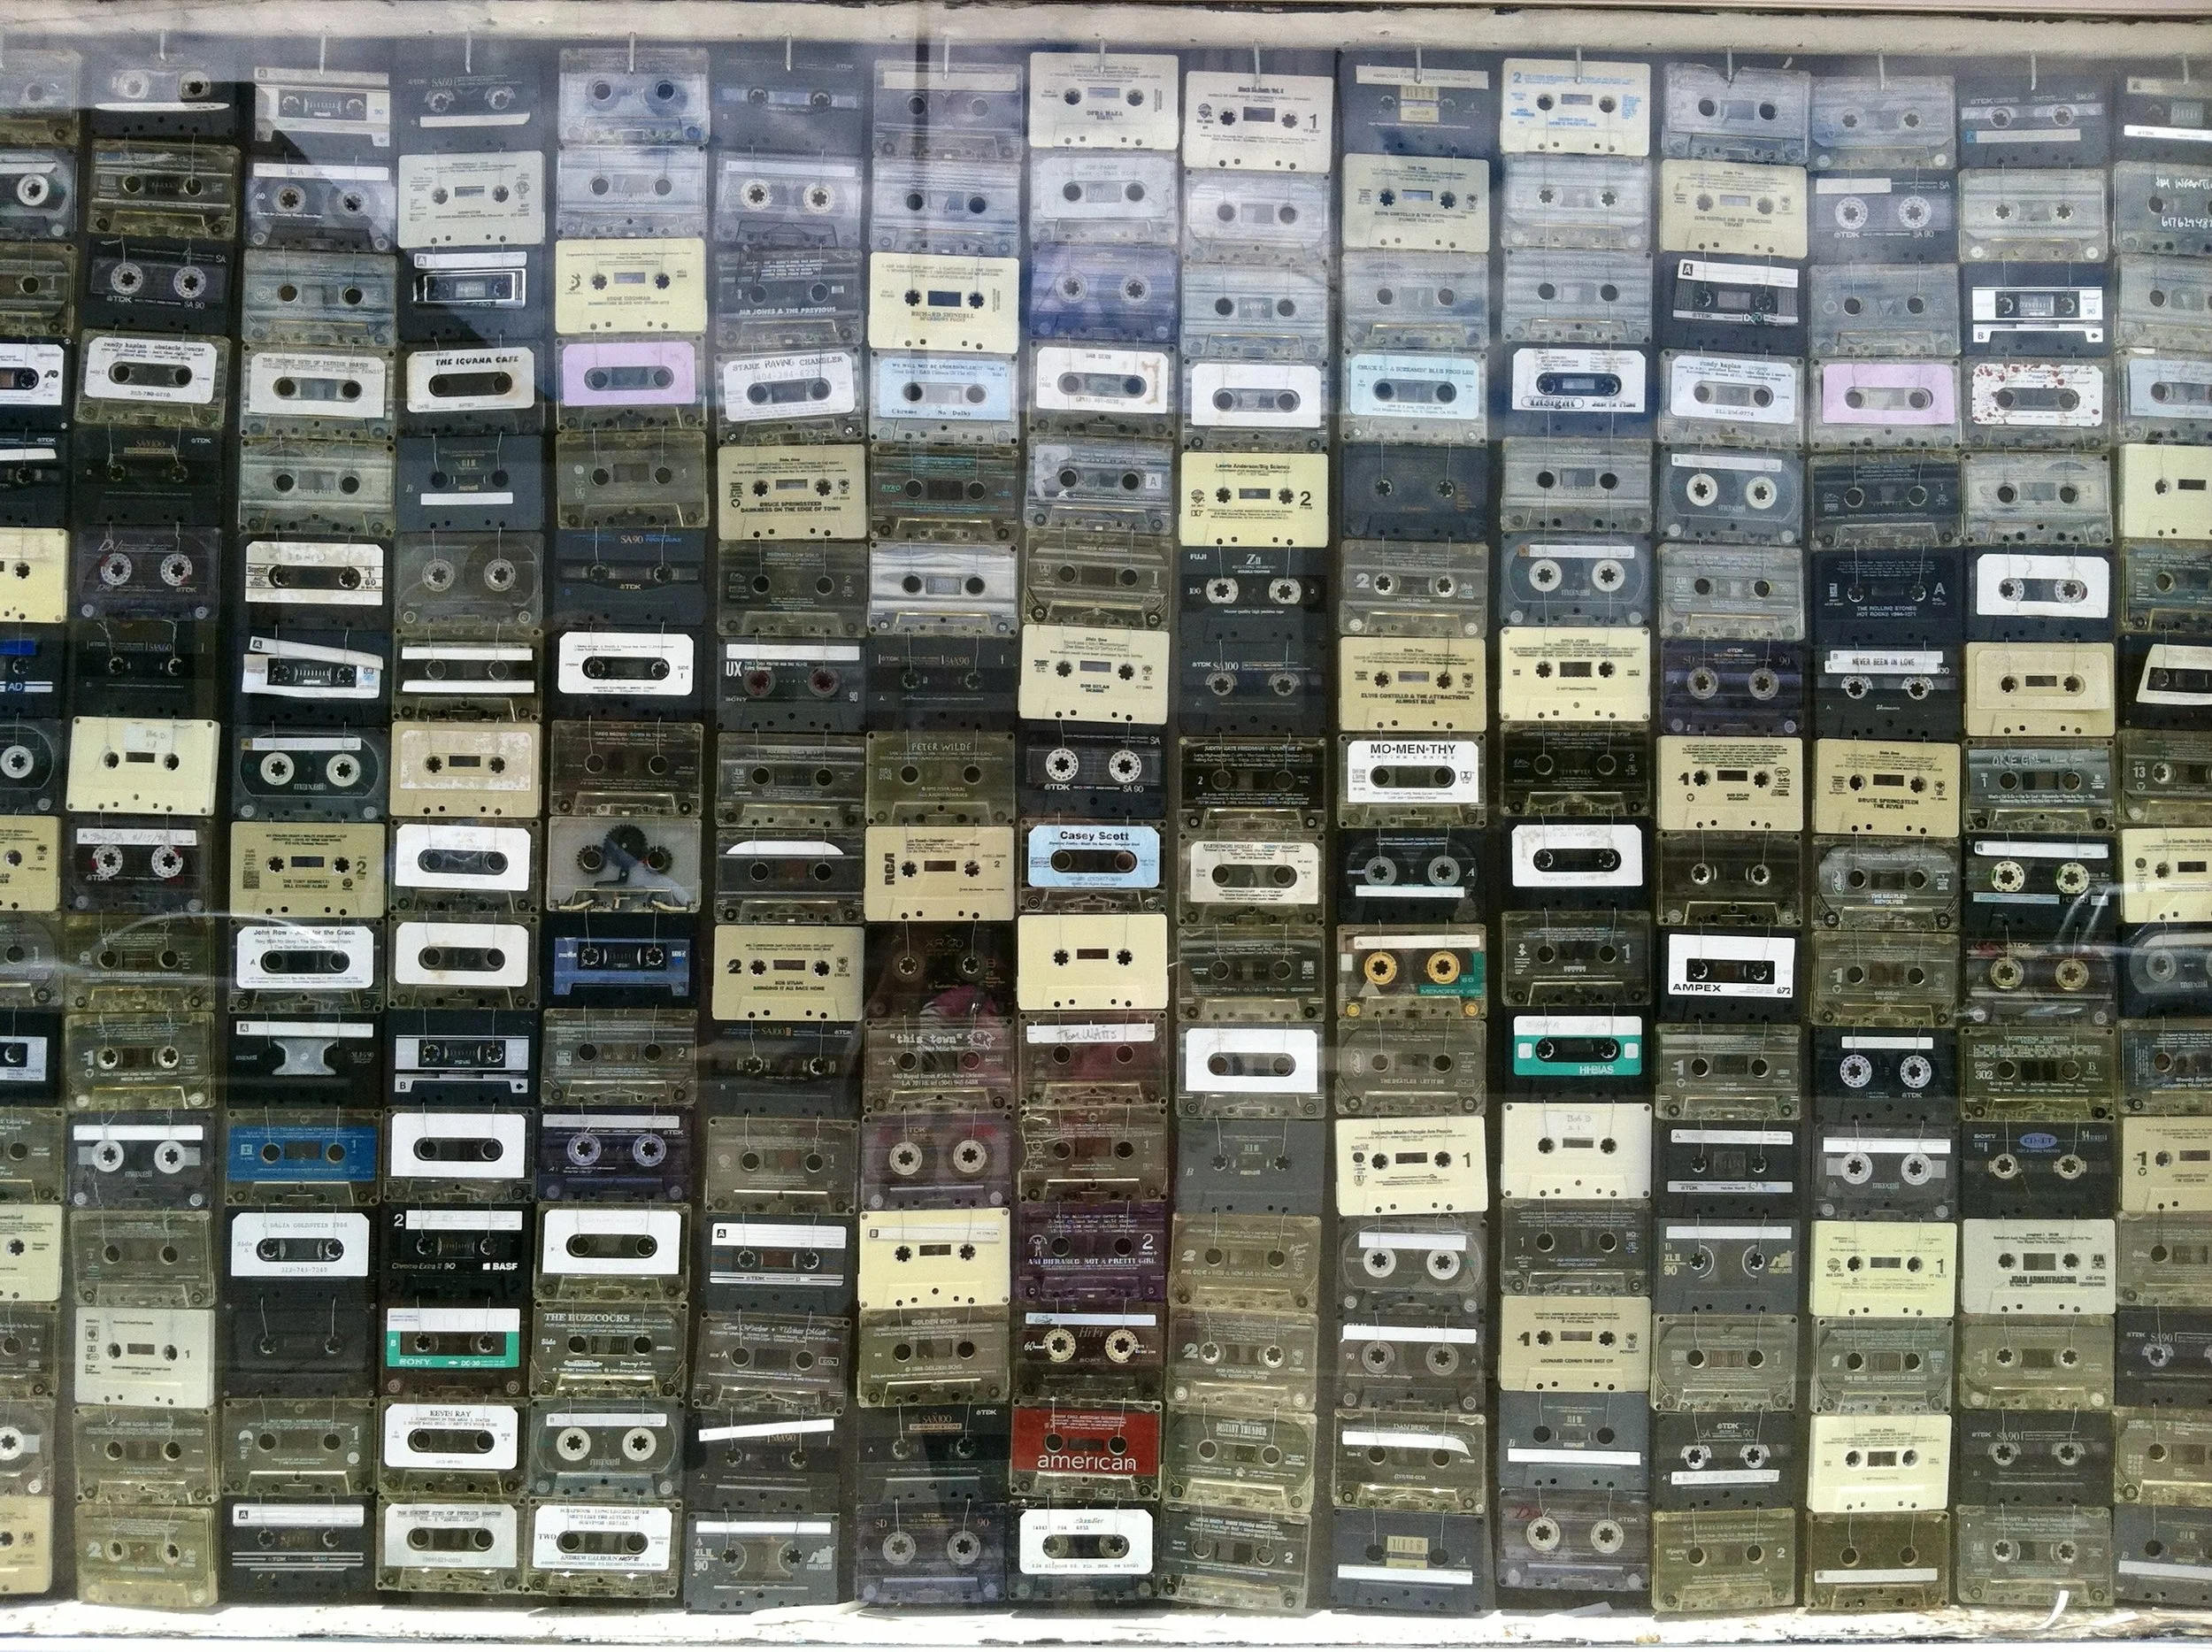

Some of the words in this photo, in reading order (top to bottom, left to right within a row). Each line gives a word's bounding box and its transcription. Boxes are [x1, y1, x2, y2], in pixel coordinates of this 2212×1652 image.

[1513, 72, 1521, 83] 2
[1310, 113, 1317, 128] 1
[215, 254, 227, 264] SA
[1683, 264, 1692, 276] A
[112, 295, 132, 304] TDK
[184, 300, 194, 309] SA
[195, 301, 205, 310] 90
[435, 357, 451, 366] THE
[456, 357, 492, 365] IGUANA
[732, 363, 761, 372] STARK
[764, 357, 795, 368] RAVING
[799, 356, 843, 366] CHANDLER
[1300, 491, 1311, 506] 2
[1356, 572, 1370, 588] 2
[1933, 584, 1945, 595] A
[1683, 656, 1695, 665] SD
[1778, 656, 1790, 666] 90
[726, 661, 741, 677] UX
[8, 682, 23, 691] AD
[849, 692, 858, 703] 90
[1150, 735, 1160, 745] SA
[911, 742, 939, 751] PETER
[941, 742, 972, 751] WILDE
[2132, 766, 2146, 778] 13
[1060, 831, 1094, 841] Casey
[1099, 830, 1129, 841] Scott
[356, 860, 366, 874] 2
[885, 852, 895, 885] RCA
[1622, 944, 1631, 959] 1
[727, 960, 741, 973] 2
[1673, 983, 1721, 993] AMPEX
[889, 1033, 923, 1044] "this
[928, 1033, 963, 1044] town"
[678, 1048, 685, 1058] 2
[888, 1055, 895, 1065] A
[1975, 1069, 1993, 1080] 302
[1462, 1152, 1471, 1168] 1
[2138, 1151, 2147, 1166] 1
[394, 1214, 403, 1226] 2
[1141, 1233, 1153, 1250] 2
[1663, 1265, 1678, 1276] 90
[544, 1313, 565, 1322] THE
[1216, 1423, 1239, 1435] DISTANT
[1699, 1428, 1711, 1439] SA
[1743, 1428, 1755, 1438] 90
[589, 1457, 620, 1466] maxell
[1038, 1455, 1136, 1471] american
[874, 1518, 887, 1528] SD
[977, 1518, 990, 1527] 90
[88, 1543, 102, 1558] 2
[1777, 1548, 1785, 1558] 2
[1284, 1551, 1293, 1564] 2
[694, 1560, 708, 1571] 90
